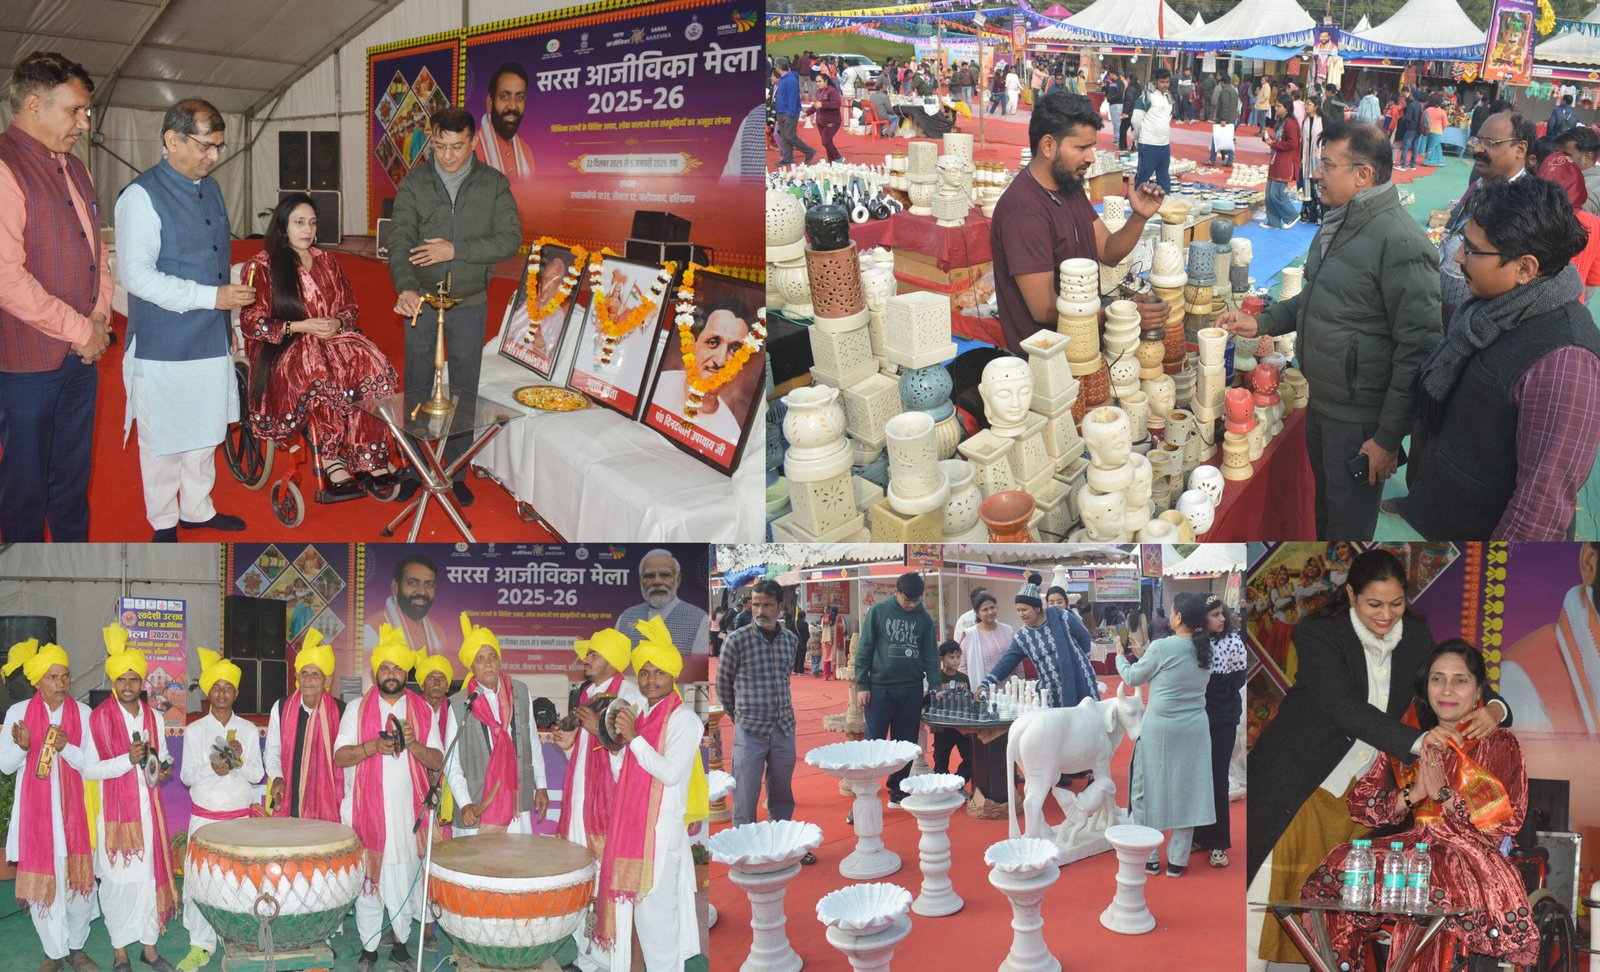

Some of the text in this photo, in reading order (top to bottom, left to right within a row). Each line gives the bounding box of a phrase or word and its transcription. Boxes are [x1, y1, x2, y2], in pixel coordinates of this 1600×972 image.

[537, 43, 762, 92] सरस आजीविका मेला
[588, 86, 684, 114] 2025-26
[586, 160, 593, 168] 22
[653, 160, 667, 168] 2026
[714, 442, 726, 457] जी
[446, 562, 629, 586] सरस आजीविका मेला
[497, 589, 578, 606] 2025-26
[137, 611, 183, 621] स्वदेशी उत्सव
